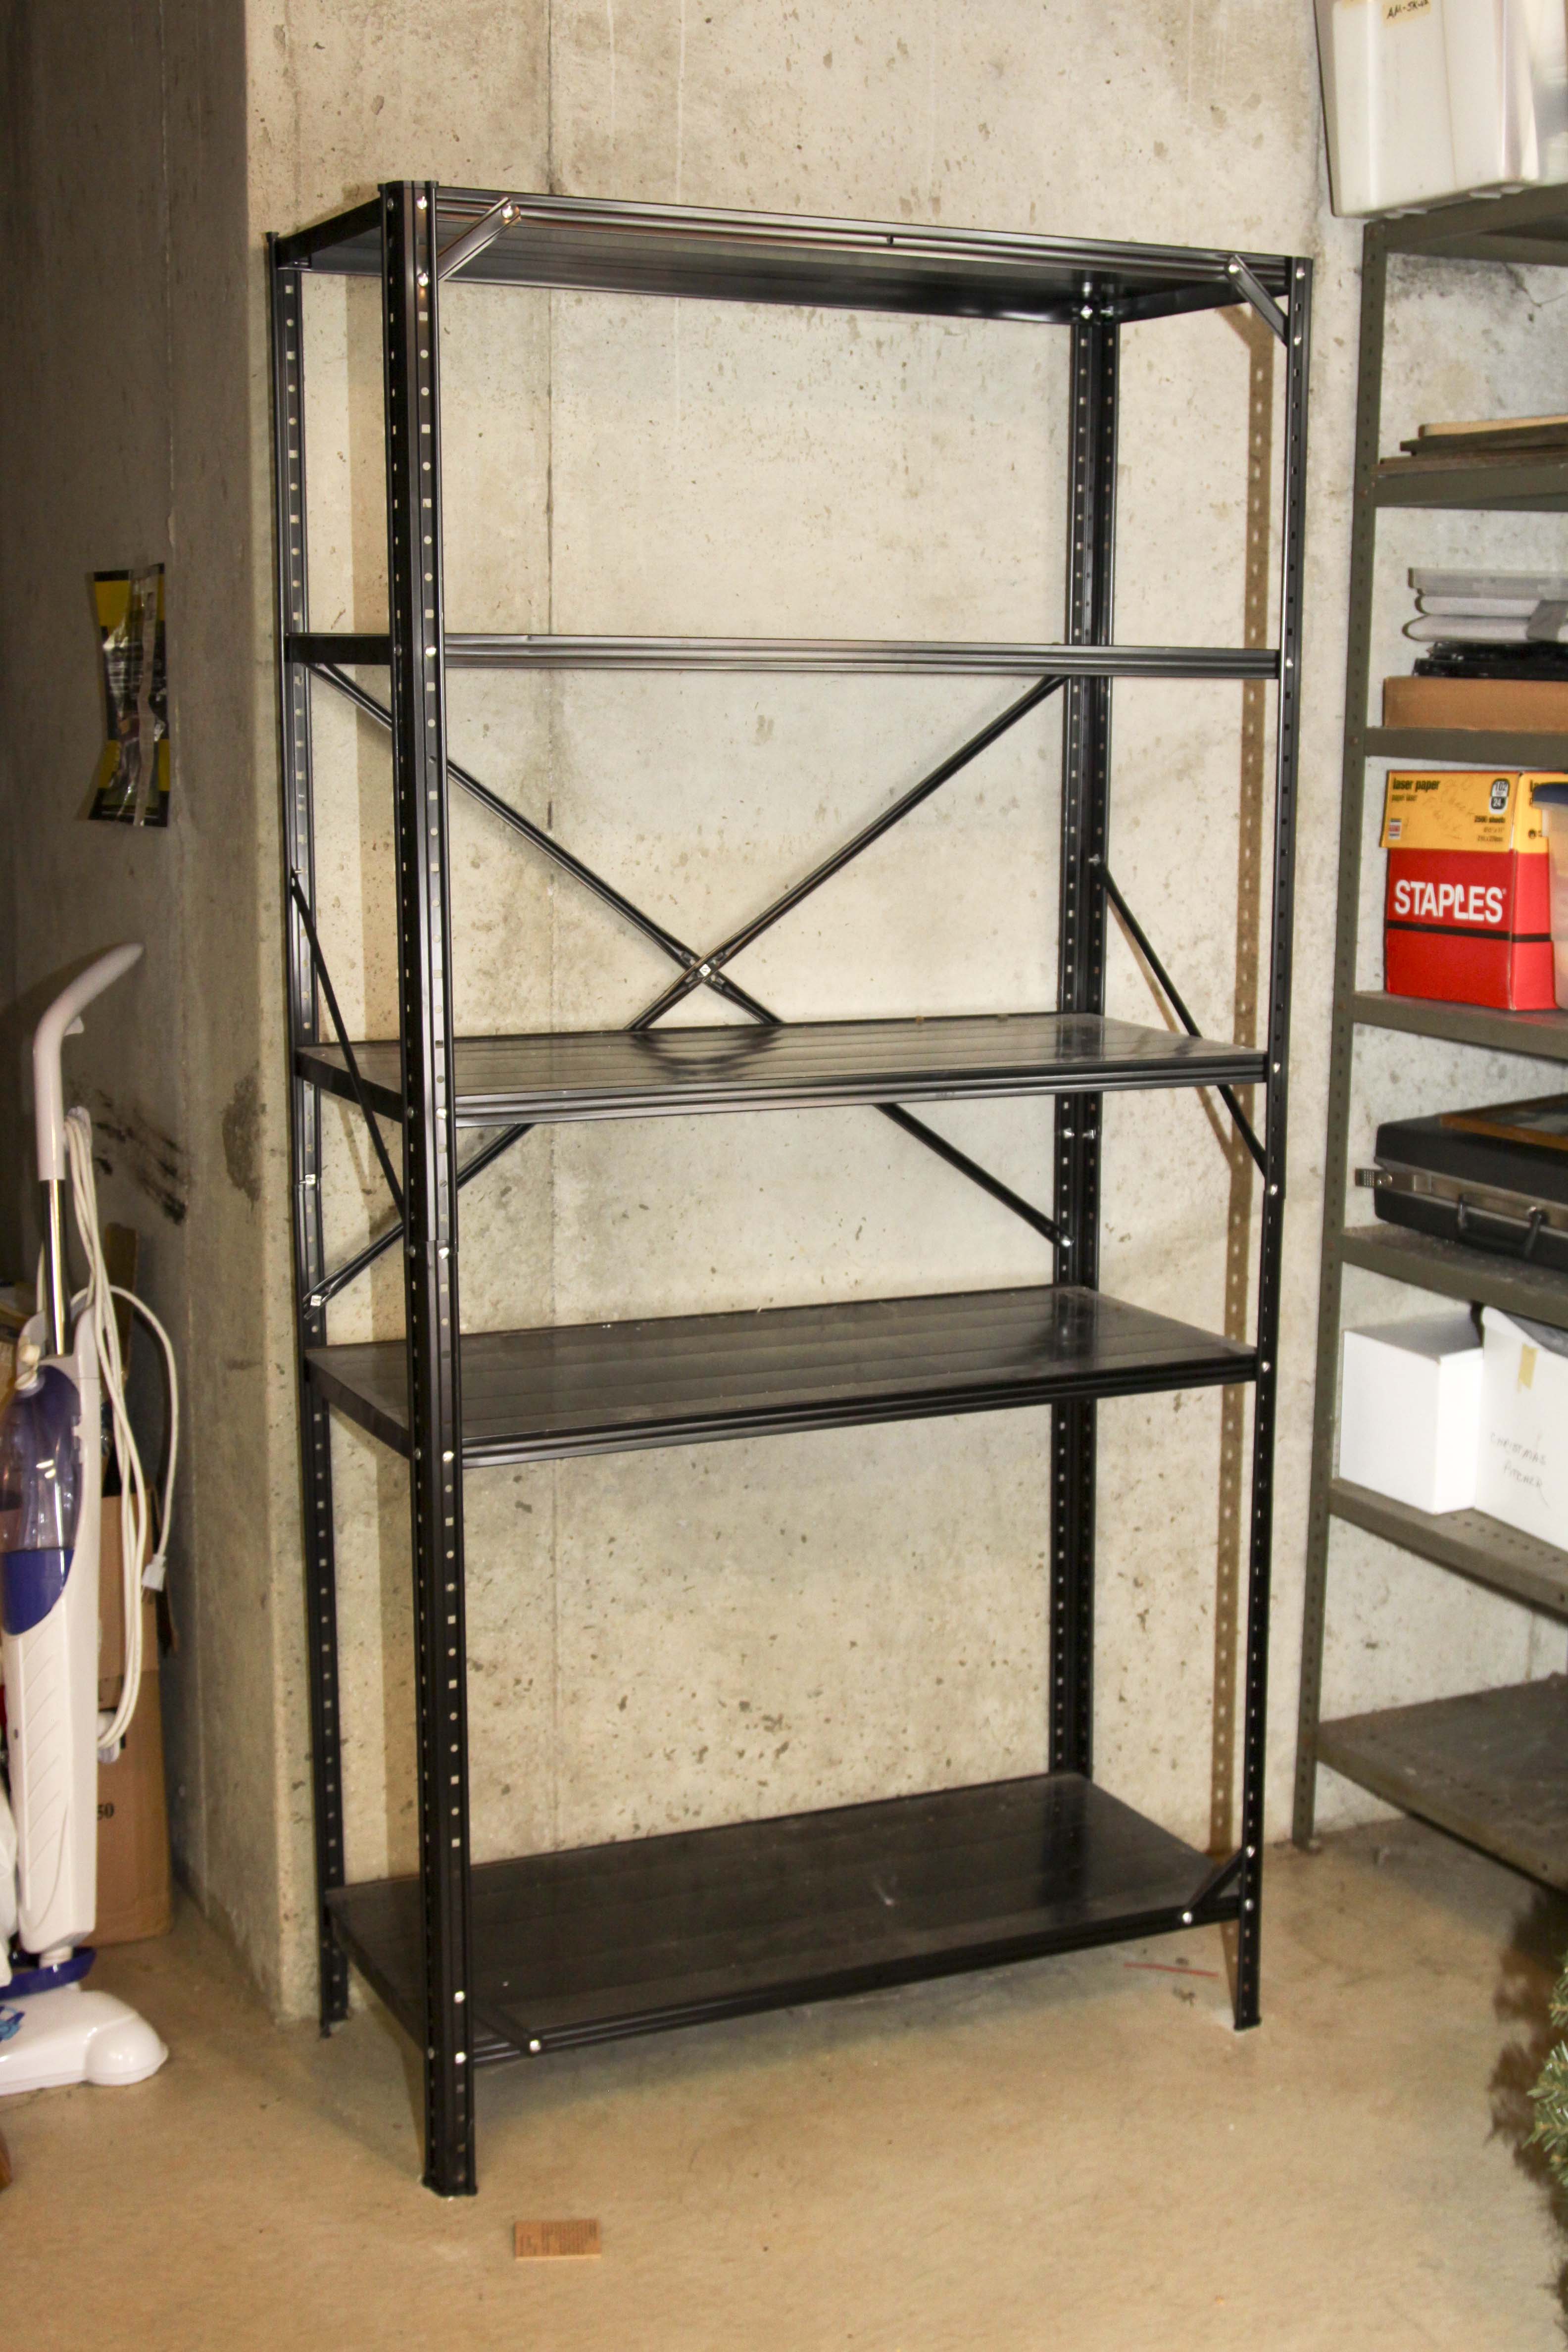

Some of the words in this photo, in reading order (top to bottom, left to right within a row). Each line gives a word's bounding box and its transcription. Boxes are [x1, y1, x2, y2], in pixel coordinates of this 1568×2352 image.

[1393, 777, 1413, 789] laser
[1415, 780, 1440, 792] paper
[1496, 782, 1508, 791] 102
[1493, 798, 1501, 807] 24
[1395, 879, 1503, 923] STAPLES
[1490, 1431, 1547, 1466] CHRISTMAS
[1503, 1459, 1545, 1493] PITCHER
